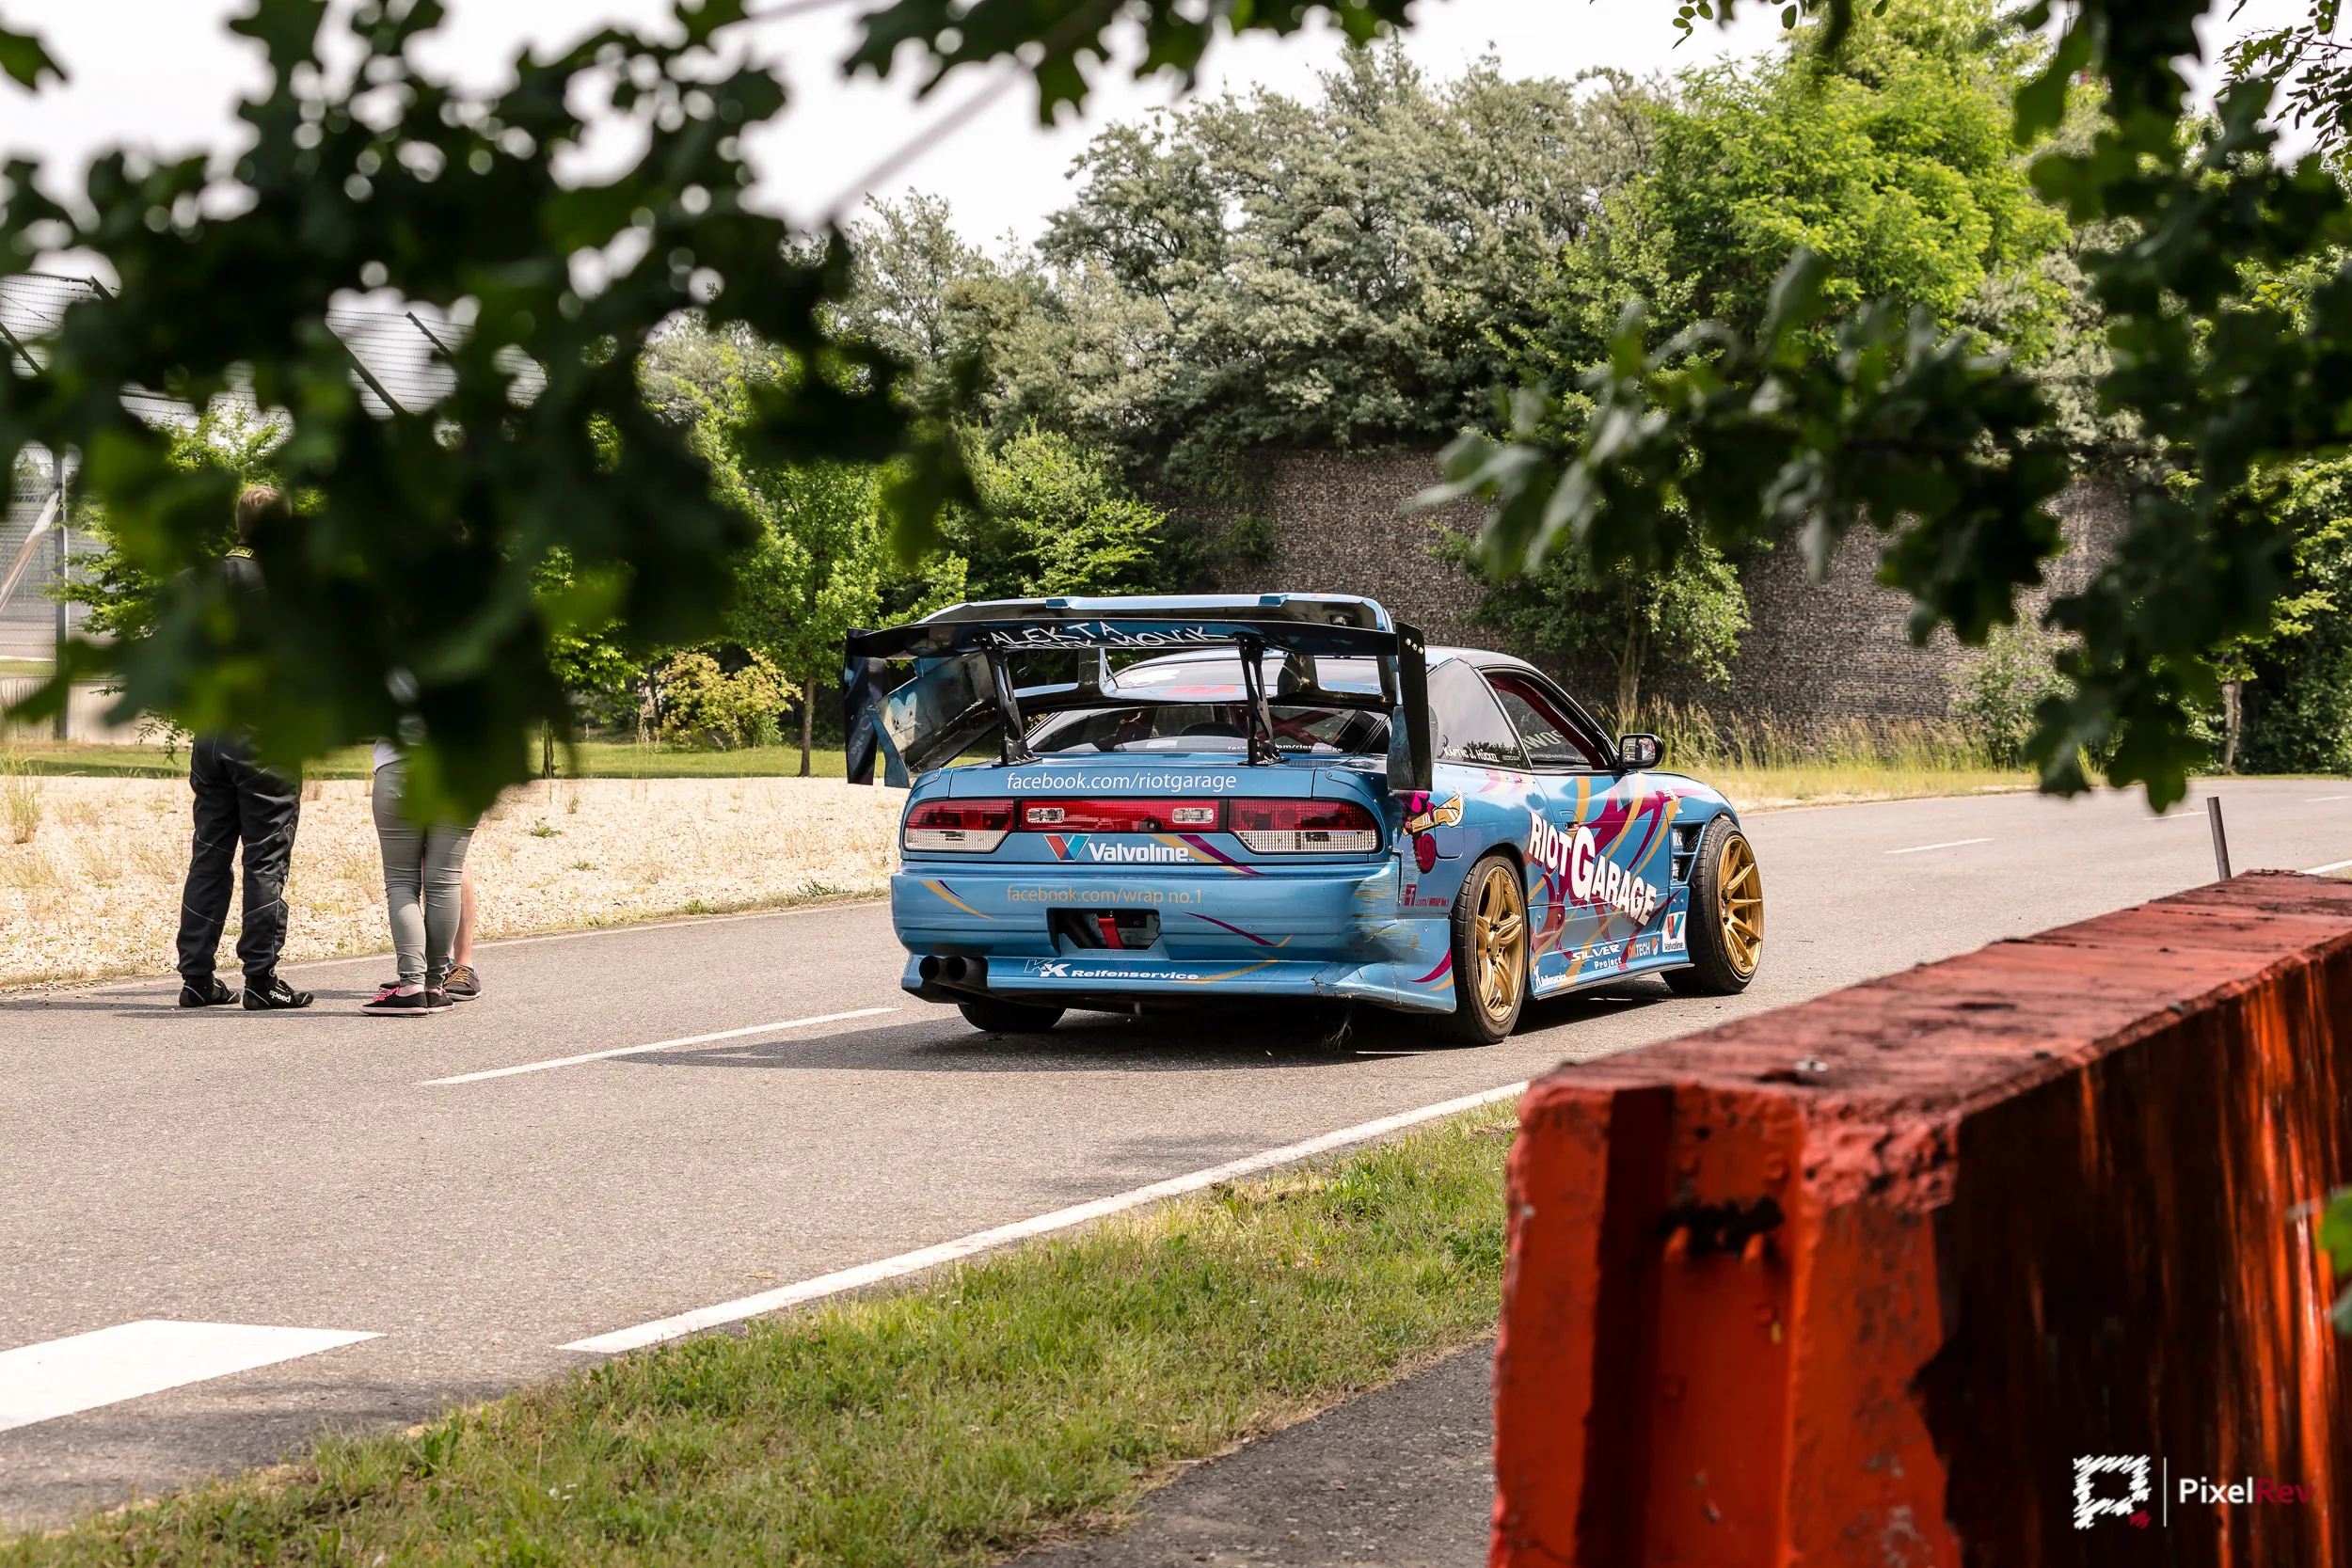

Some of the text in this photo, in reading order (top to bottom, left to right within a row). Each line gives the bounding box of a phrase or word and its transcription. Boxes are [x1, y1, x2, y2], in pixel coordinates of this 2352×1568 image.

[1007, 772, 1237, 792] facebook.com/riotgarage
[1089, 843, 1189, 862] Valvoline
[1007, 885, 1201, 906] facebook.com/wrap no.1
[1571, 944, 1621, 962] SILVER
[1663, 942, 1684, 951] Valvoline
[1595, 956, 1621, 970] Project
[1072, 970, 1200, 981] Reifenservice
[269, 990, 291, 1004] speed
